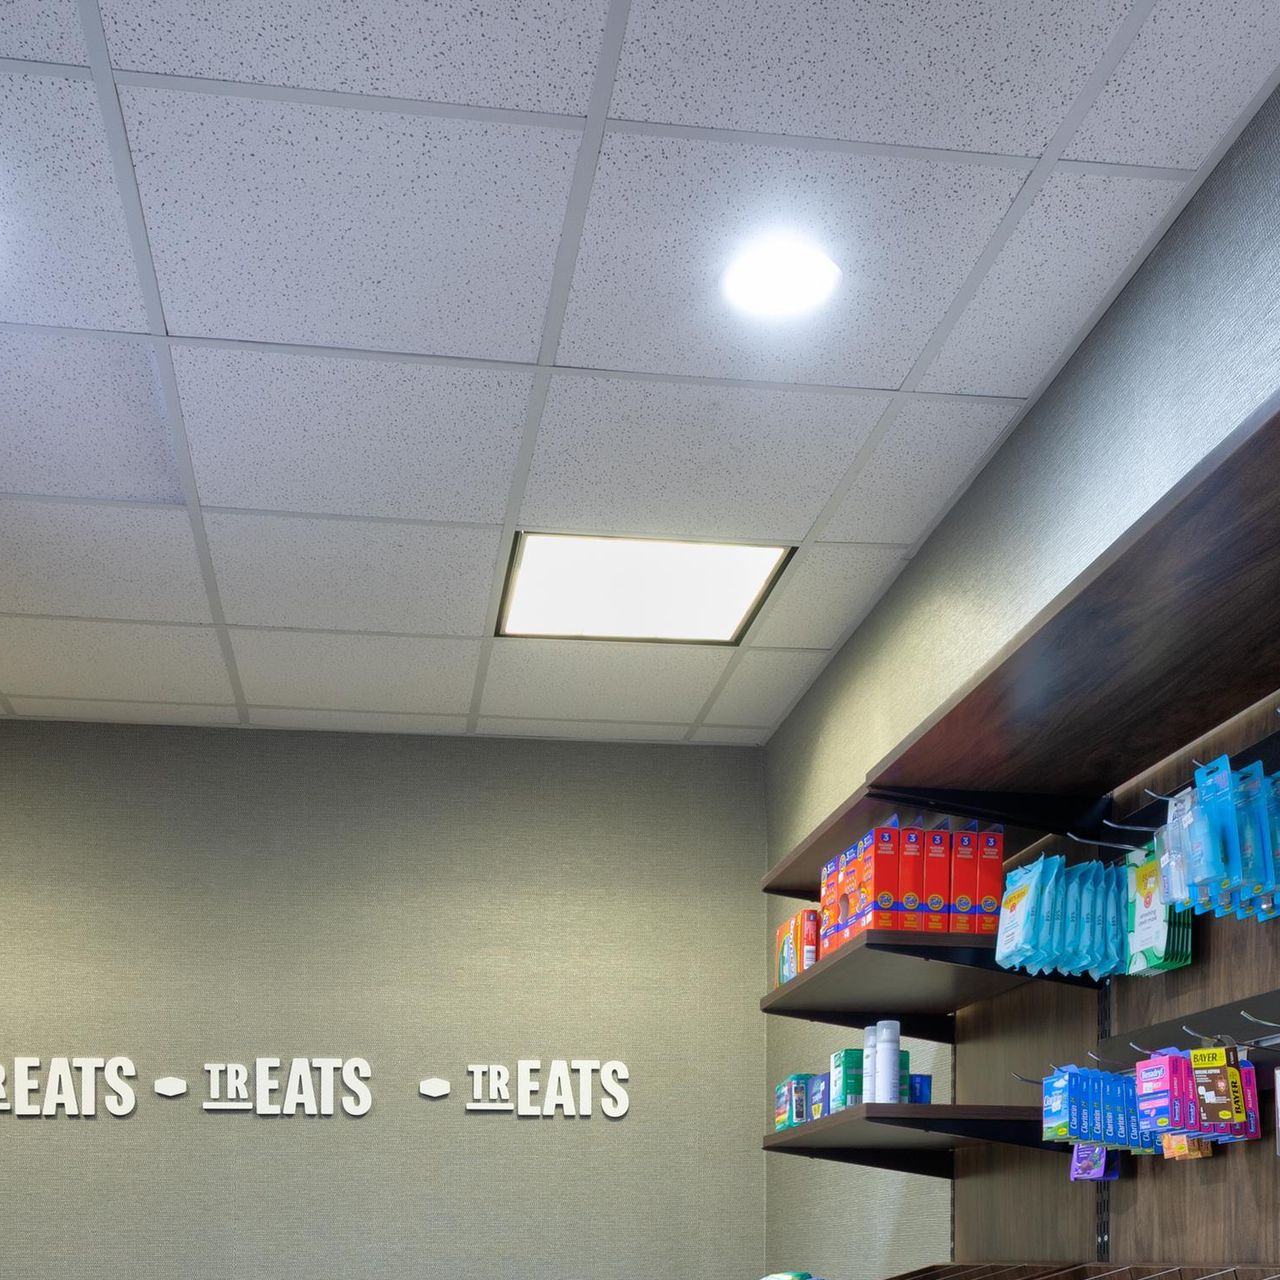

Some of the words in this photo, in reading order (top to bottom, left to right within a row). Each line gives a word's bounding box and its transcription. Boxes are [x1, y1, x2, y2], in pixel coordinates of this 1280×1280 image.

[882, 833, 890, 841] 3
[909, 834, 917, 842] 3
[934, 835, 941, 844] 3
[962, 836, 969, 845] 3
[988, 837, 995, 846] 3
[1193, 1053, 1218, 1063] BAYER
[1141, 1067, 1164, 1079] Benadryl
[202, 1056, 372, 1117] TREATS
[465, 1060, 630, 1118] TREATS
[1231, 1081, 1242, 1114] BAYER
[1106, 1111, 1114, 1136] Claritin
